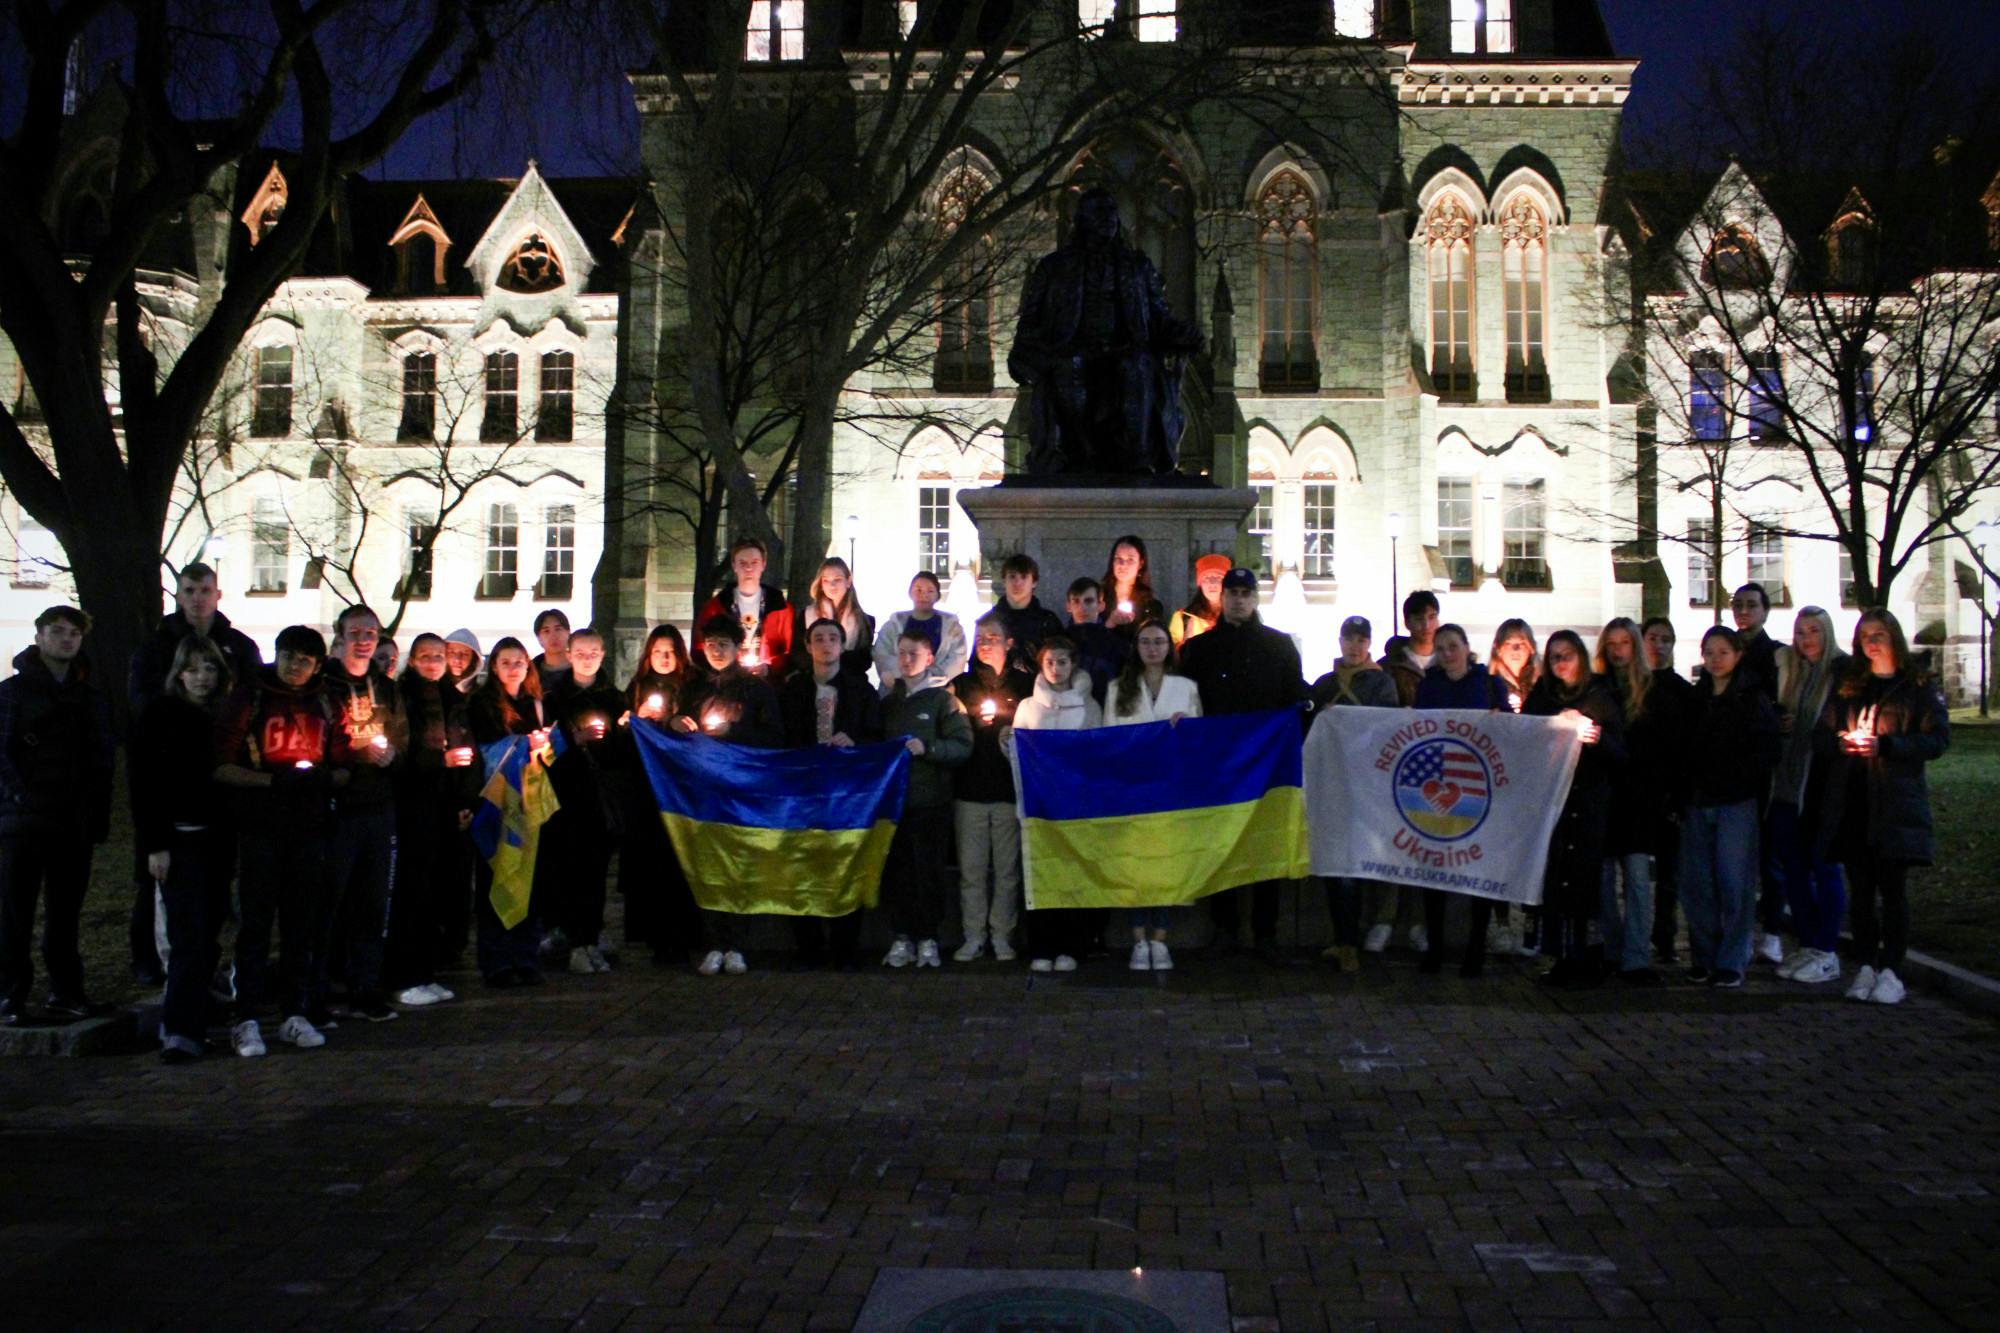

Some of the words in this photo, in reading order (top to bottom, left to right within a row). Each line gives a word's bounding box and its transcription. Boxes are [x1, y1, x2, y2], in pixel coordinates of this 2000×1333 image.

[1374, 719, 1438, 772] REVIVED
[1445, 718, 1509, 787] SOLDIERS
[1393, 828, 1482, 867] Ukraine
